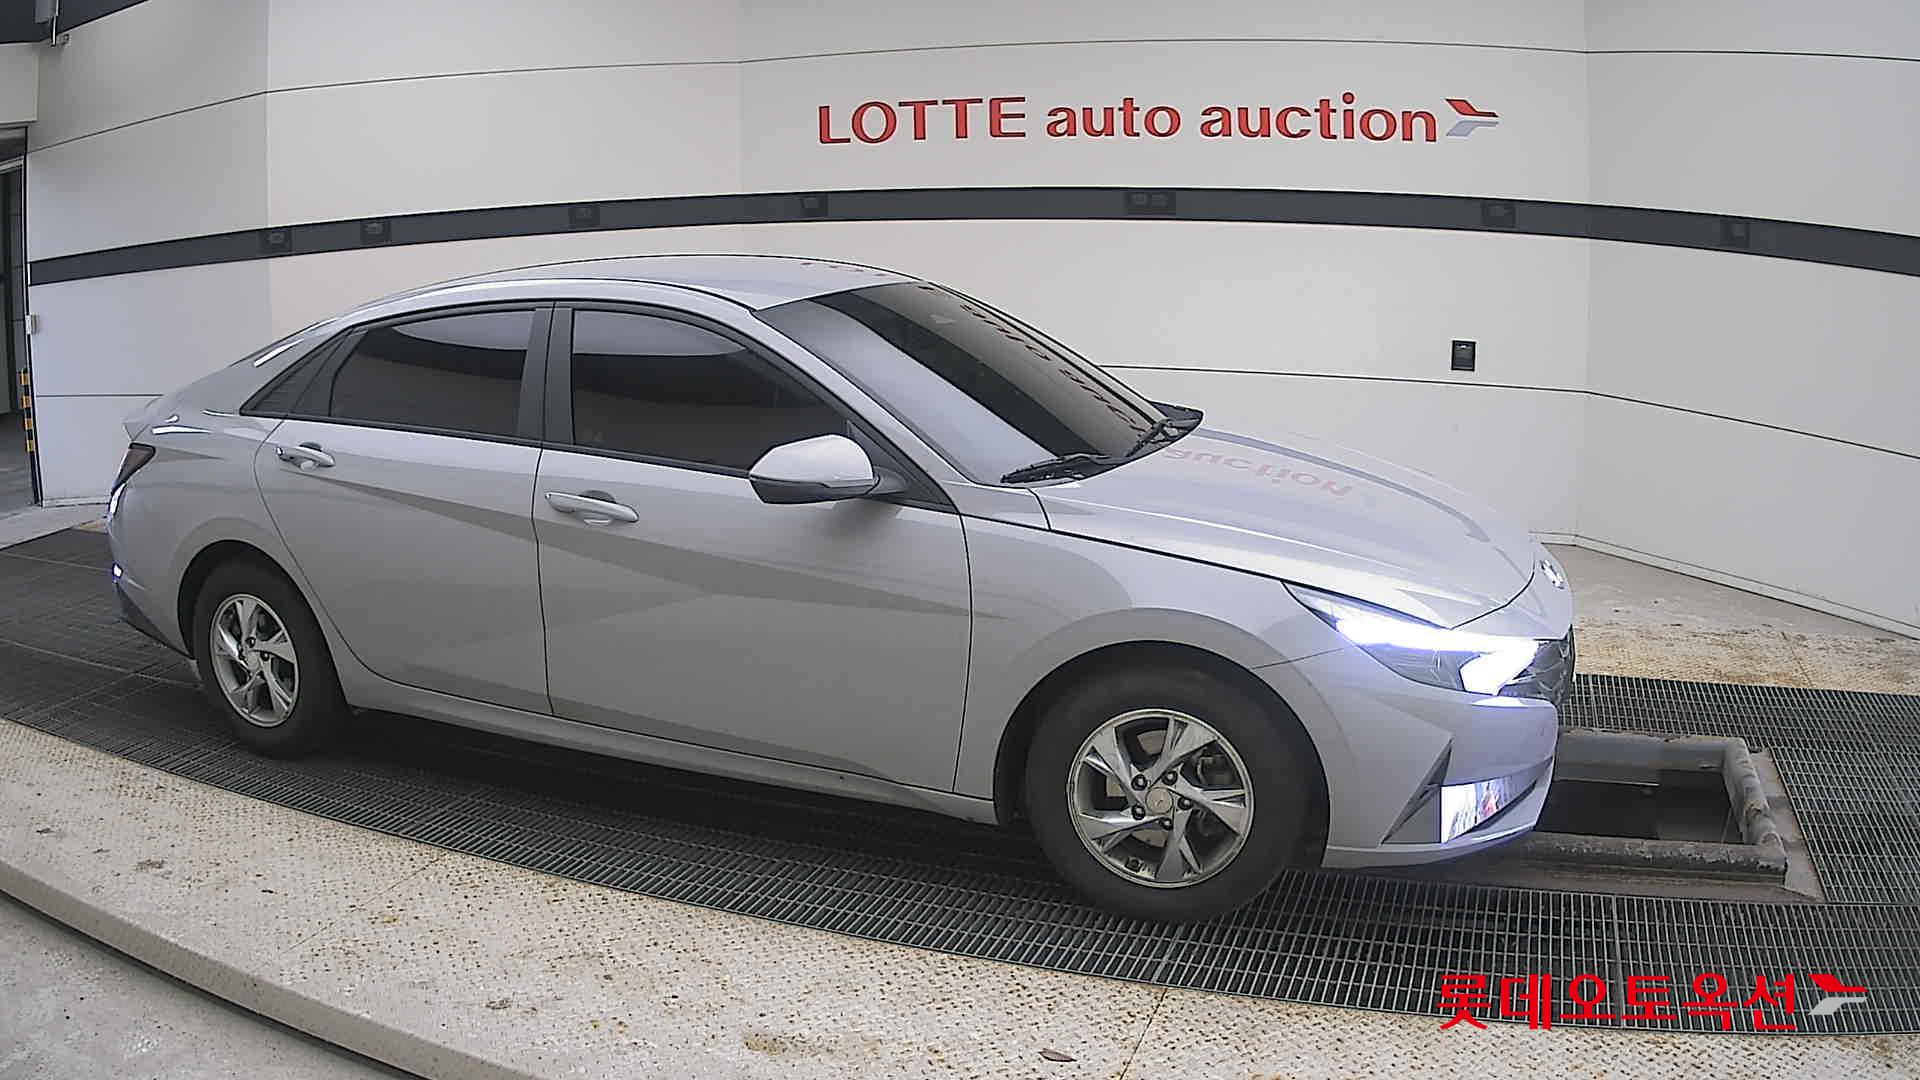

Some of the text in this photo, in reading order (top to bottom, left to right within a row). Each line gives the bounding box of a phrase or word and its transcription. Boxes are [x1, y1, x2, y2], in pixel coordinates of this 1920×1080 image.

[818, 92, 1439, 144] LOTTE auto auction
